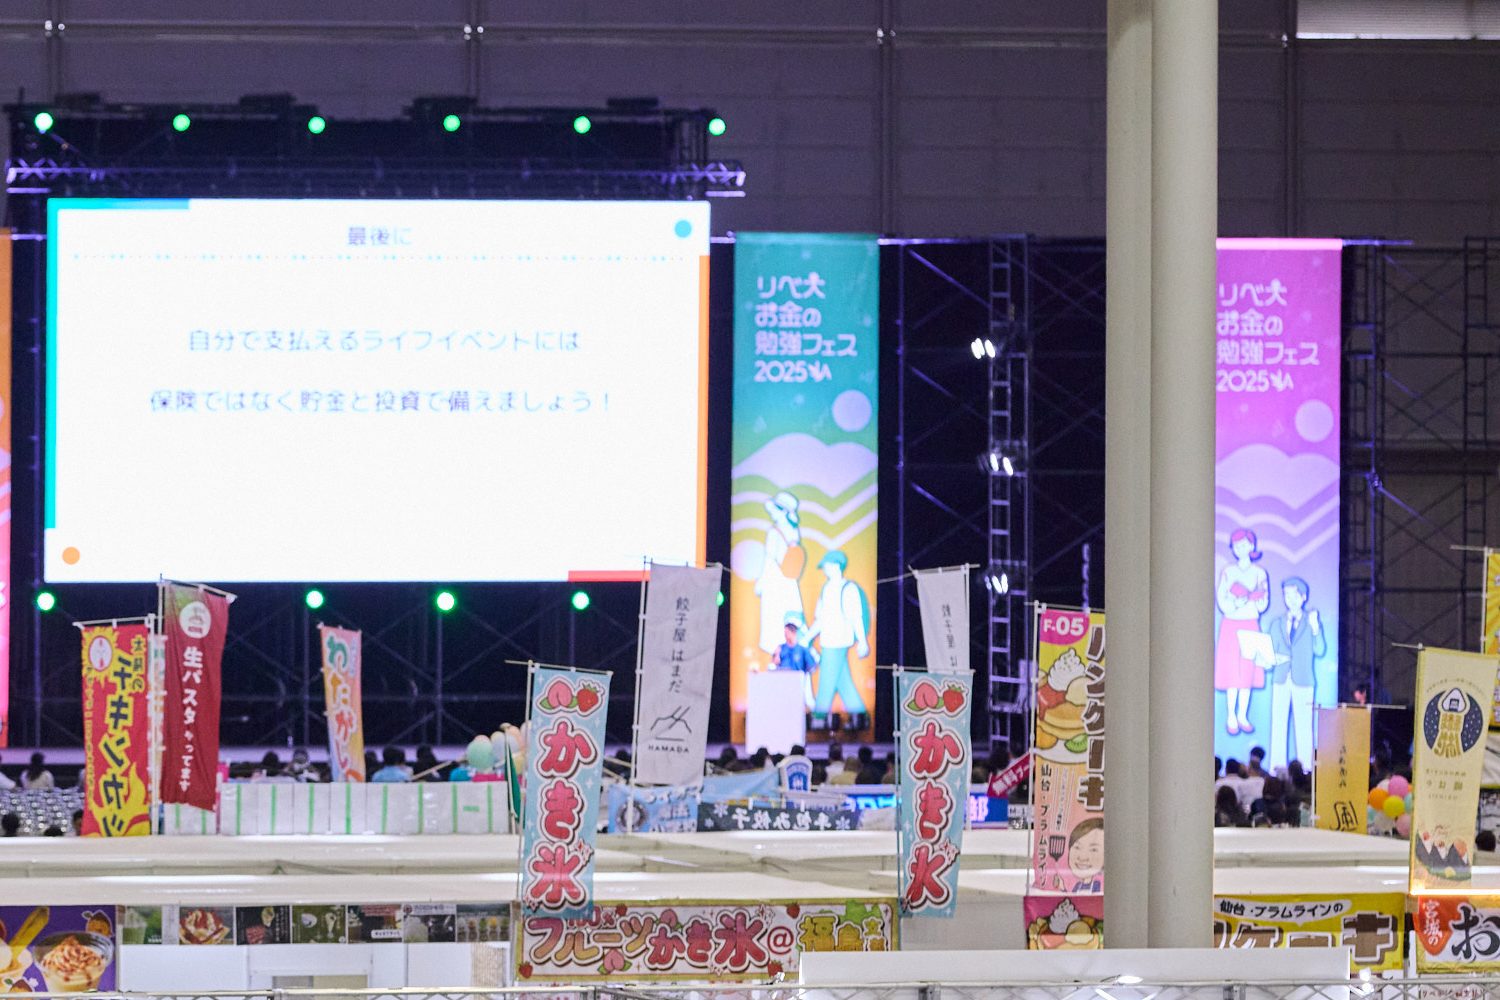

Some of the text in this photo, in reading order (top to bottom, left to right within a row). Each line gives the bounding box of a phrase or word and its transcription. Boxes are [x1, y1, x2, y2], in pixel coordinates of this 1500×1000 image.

[347, 226, 412, 247] 最後に
[757, 271, 826, 299] リベ大
[1219, 278, 1287, 307] リベ大
[754, 300, 821, 328] お金の
[1216, 307, 1283, 336] お金の
[189, 329, 581, 352] 自分で支払えるライフイベントには
[754, 330, 858, 356] 勉強フェス
[1216, 338, 1319, 365] 勉強フェス
[754, 360, 808, 382] 2025
[1216, 369, 1269, 392] 2025
[648, 744, 690, 754] HAMADA
[525, 718, 597, 908] かき氷
[904, 719, 964, 908] かき氷
[1219, 899, 1344, 920] 仙台・プラムラインの
[1421, 898, 1443, 947] 宮城の
